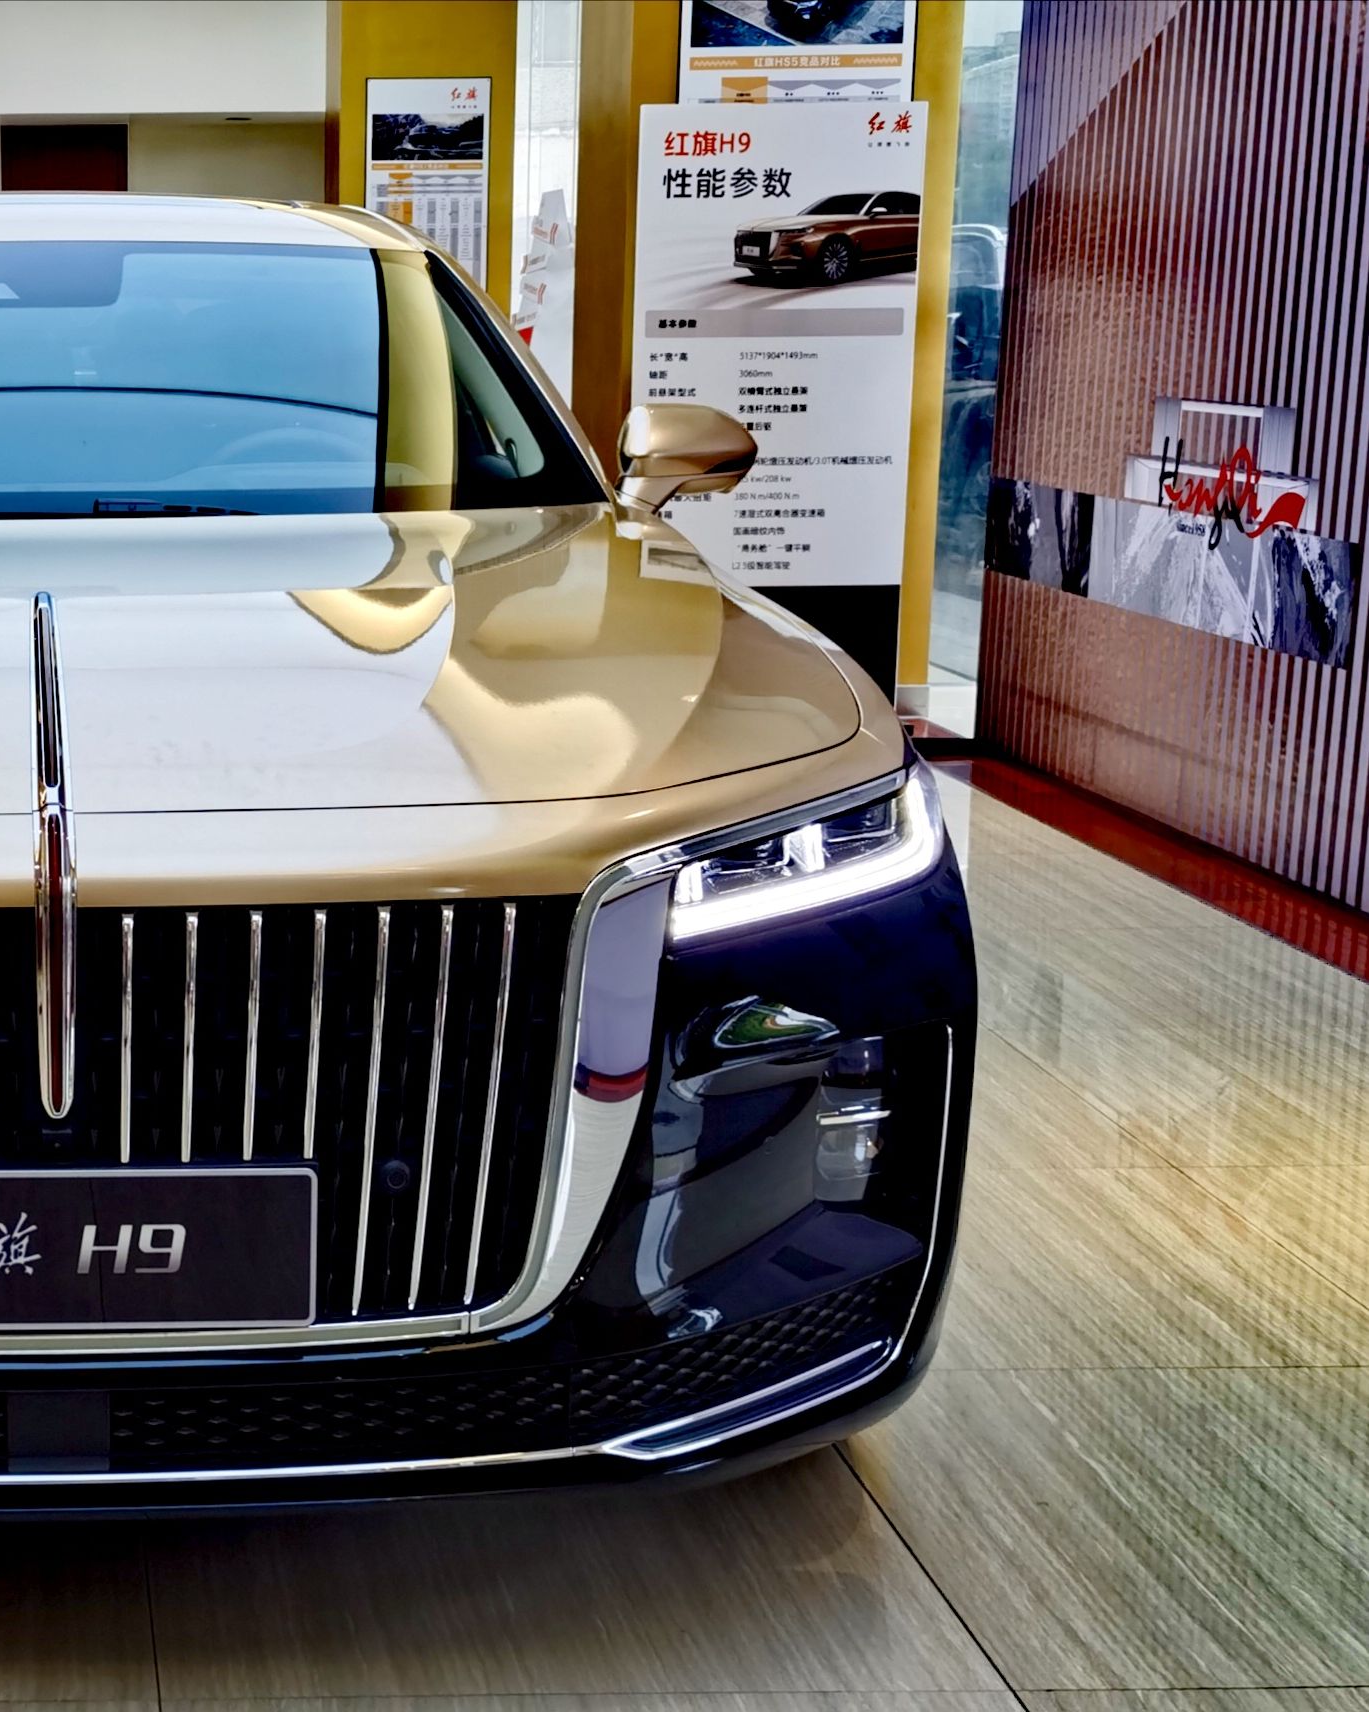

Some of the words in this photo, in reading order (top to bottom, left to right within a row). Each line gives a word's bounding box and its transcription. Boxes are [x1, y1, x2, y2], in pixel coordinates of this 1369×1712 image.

[450, 86, 478, 101] 红旗
[868, 110, 912, 135] 红旗
[664, 131, 751, 156] 红旗H9
[663, 167, 792, 199] 性能参数
[739, 369, 773, 378] 3060mm
[76, 1223, 187, 1275] H9
